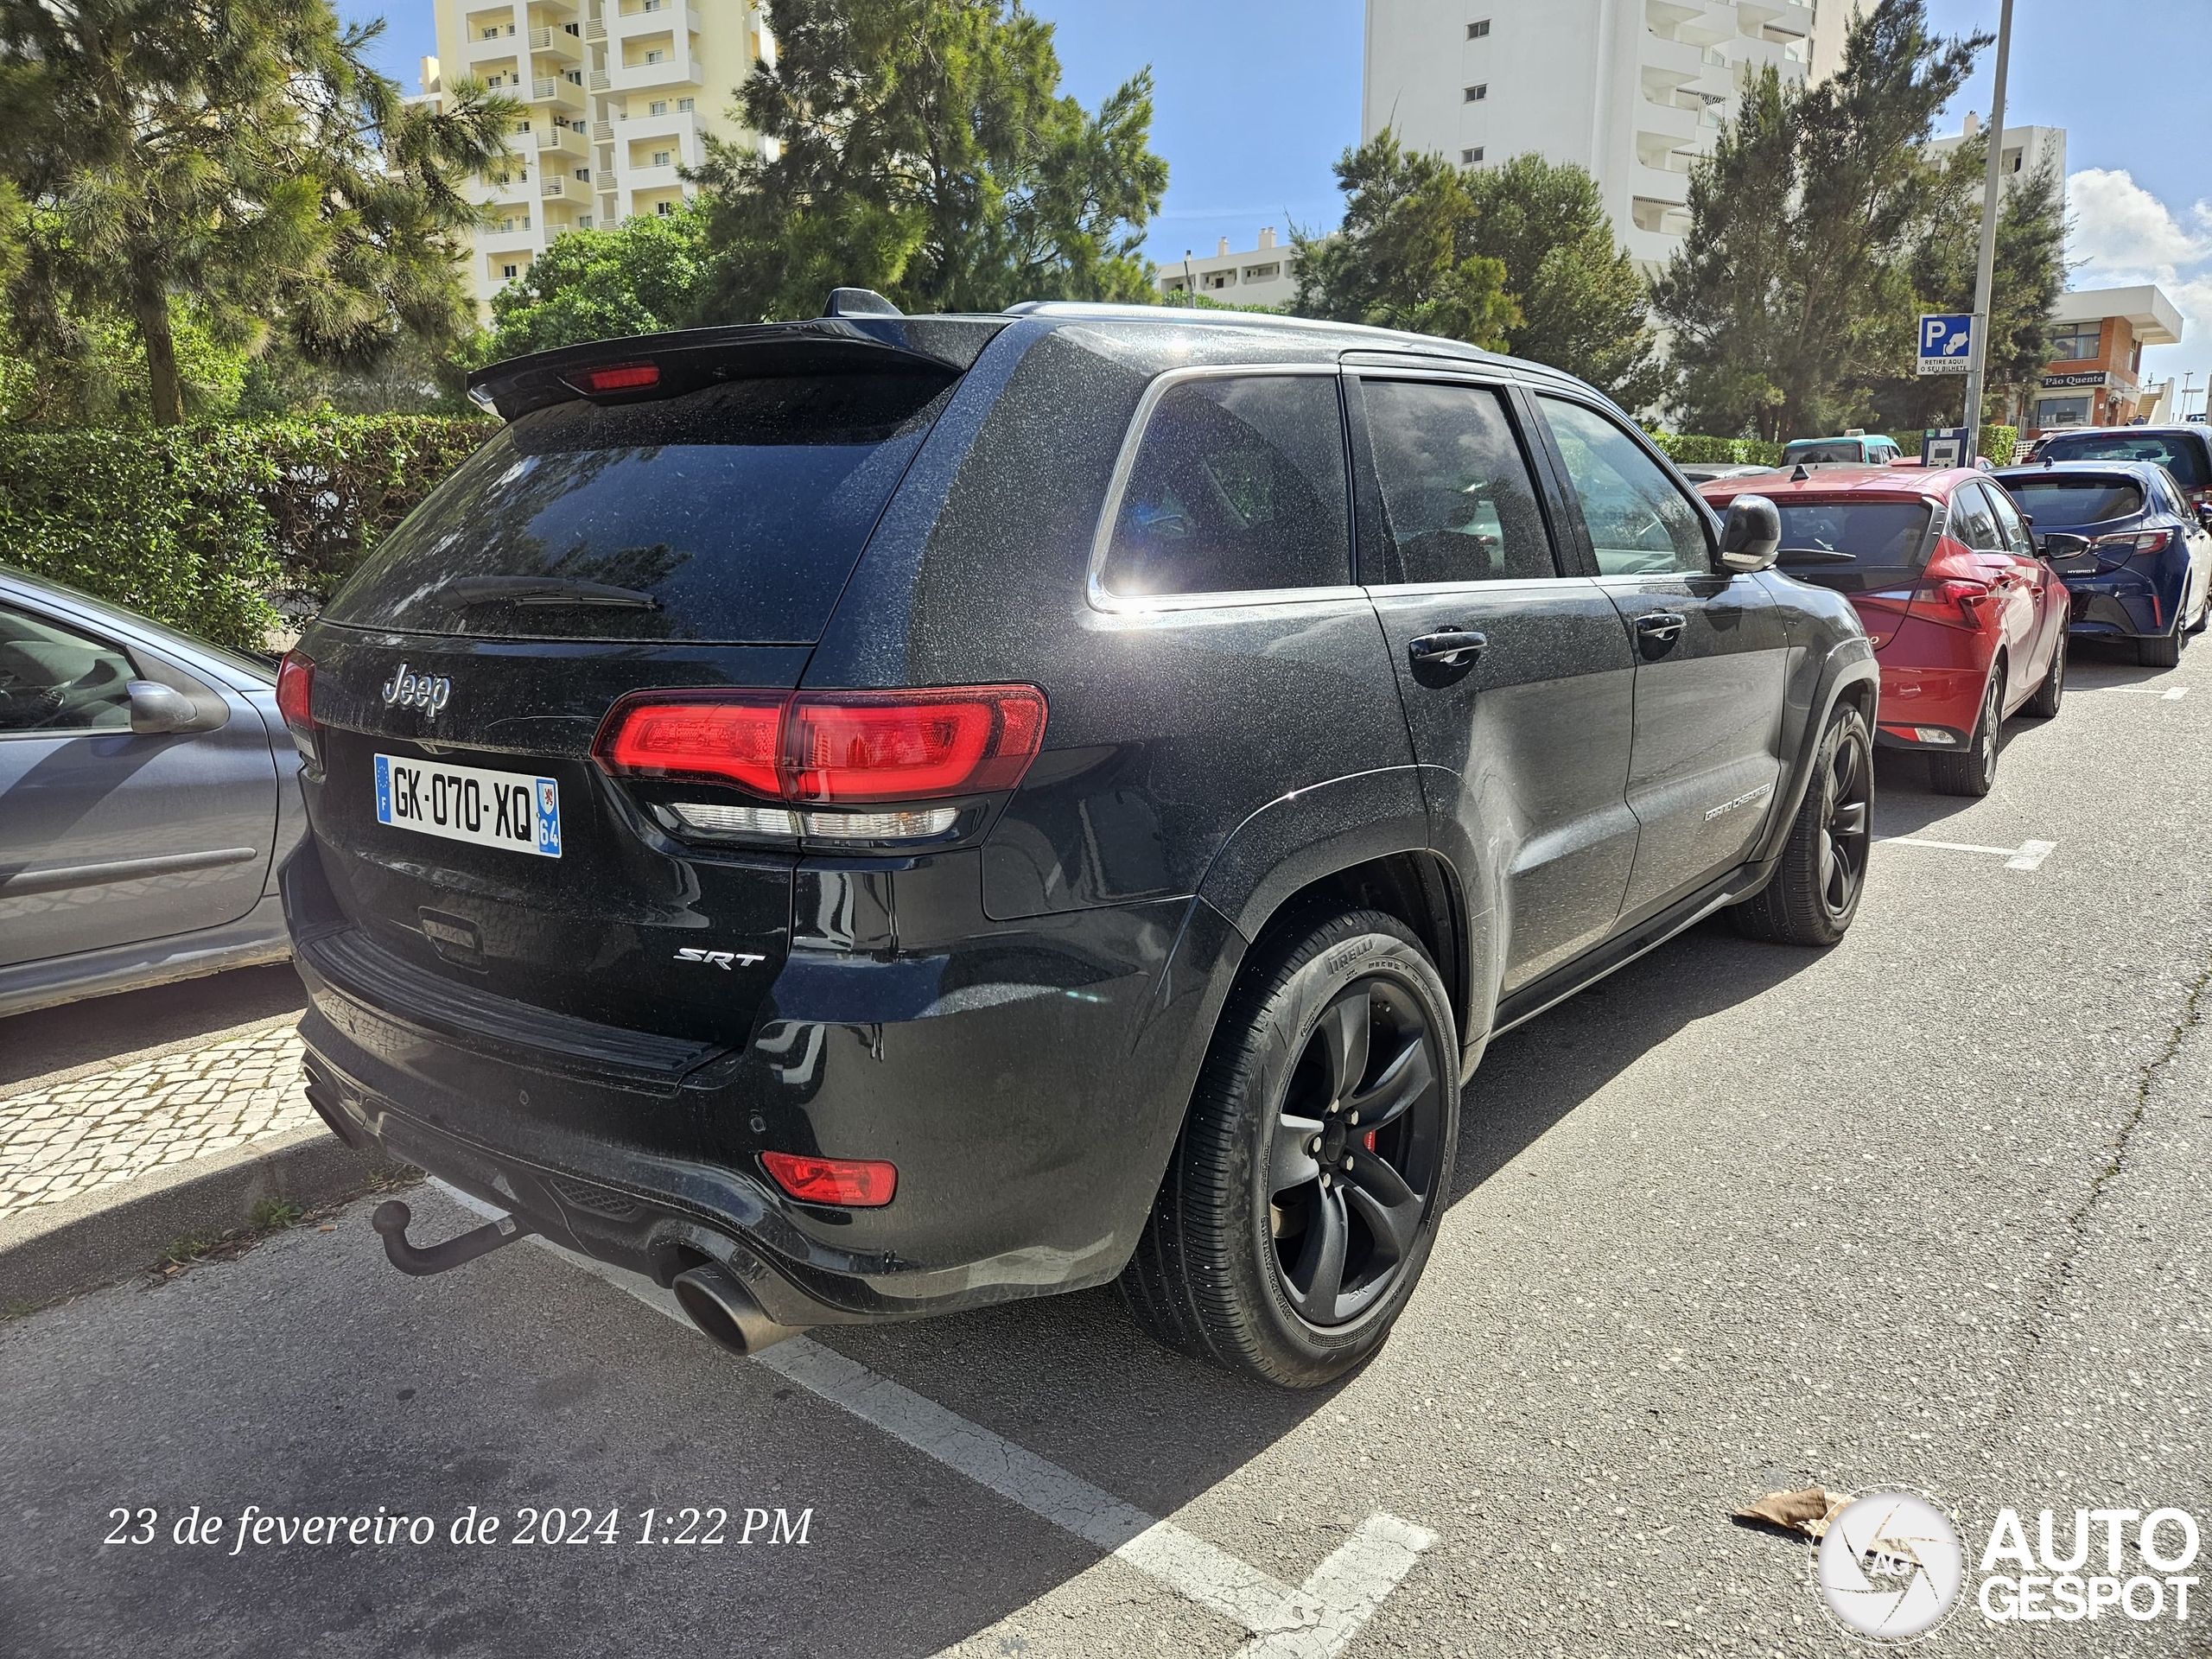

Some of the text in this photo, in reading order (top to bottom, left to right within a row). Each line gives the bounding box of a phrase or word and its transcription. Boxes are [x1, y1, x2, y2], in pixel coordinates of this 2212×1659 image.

[1926, 321, 1946, 347] P
[2067, 375, 2103, 385] Quente
[382, 663, 450, 718] Jeep
[381, 797, 386, 810] F
[539, 819, 559, 847] 64
[673, 948, 766, 970] SRT
[1322, 938, 1374, 978] PIRELLI
